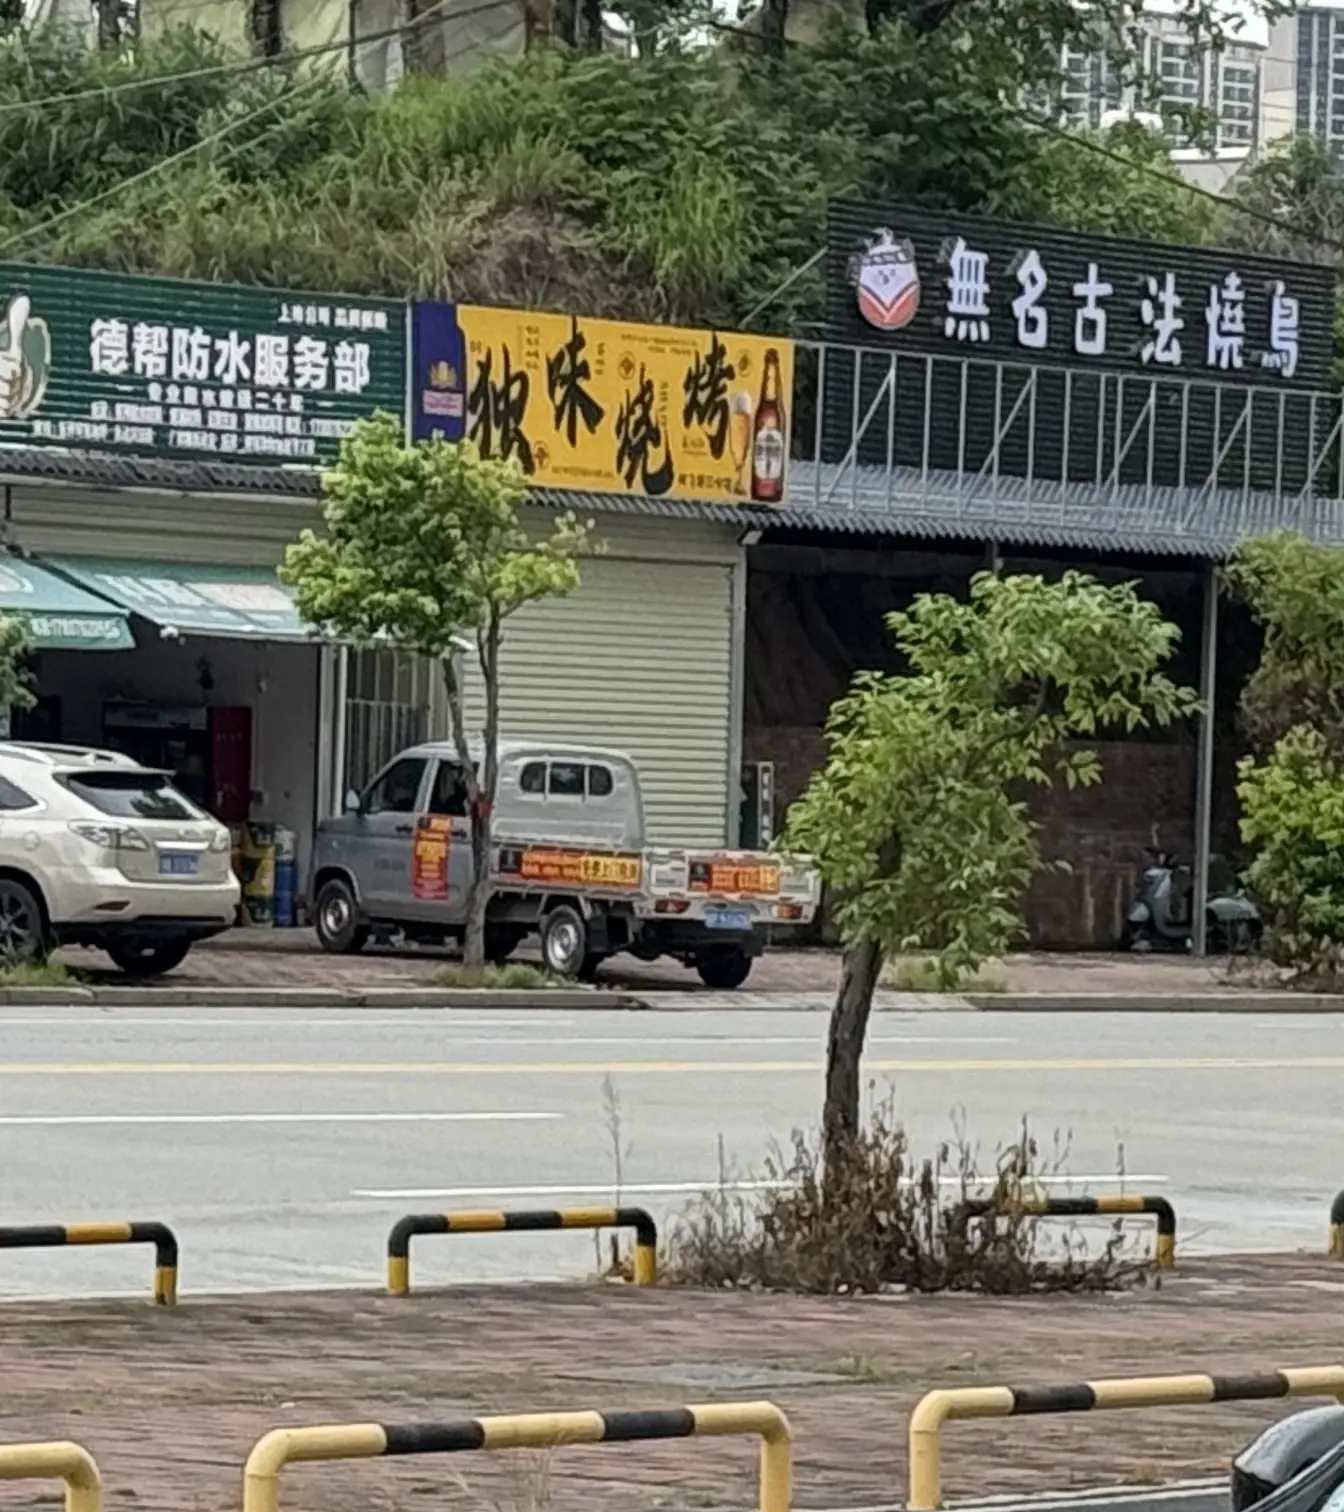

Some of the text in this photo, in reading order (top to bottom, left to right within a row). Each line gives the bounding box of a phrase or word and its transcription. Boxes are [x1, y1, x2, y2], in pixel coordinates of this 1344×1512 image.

[89, 317, 371, 394] 德帮防水服务部
[944, 235, 1301, 379] 無名古法燒鳥
